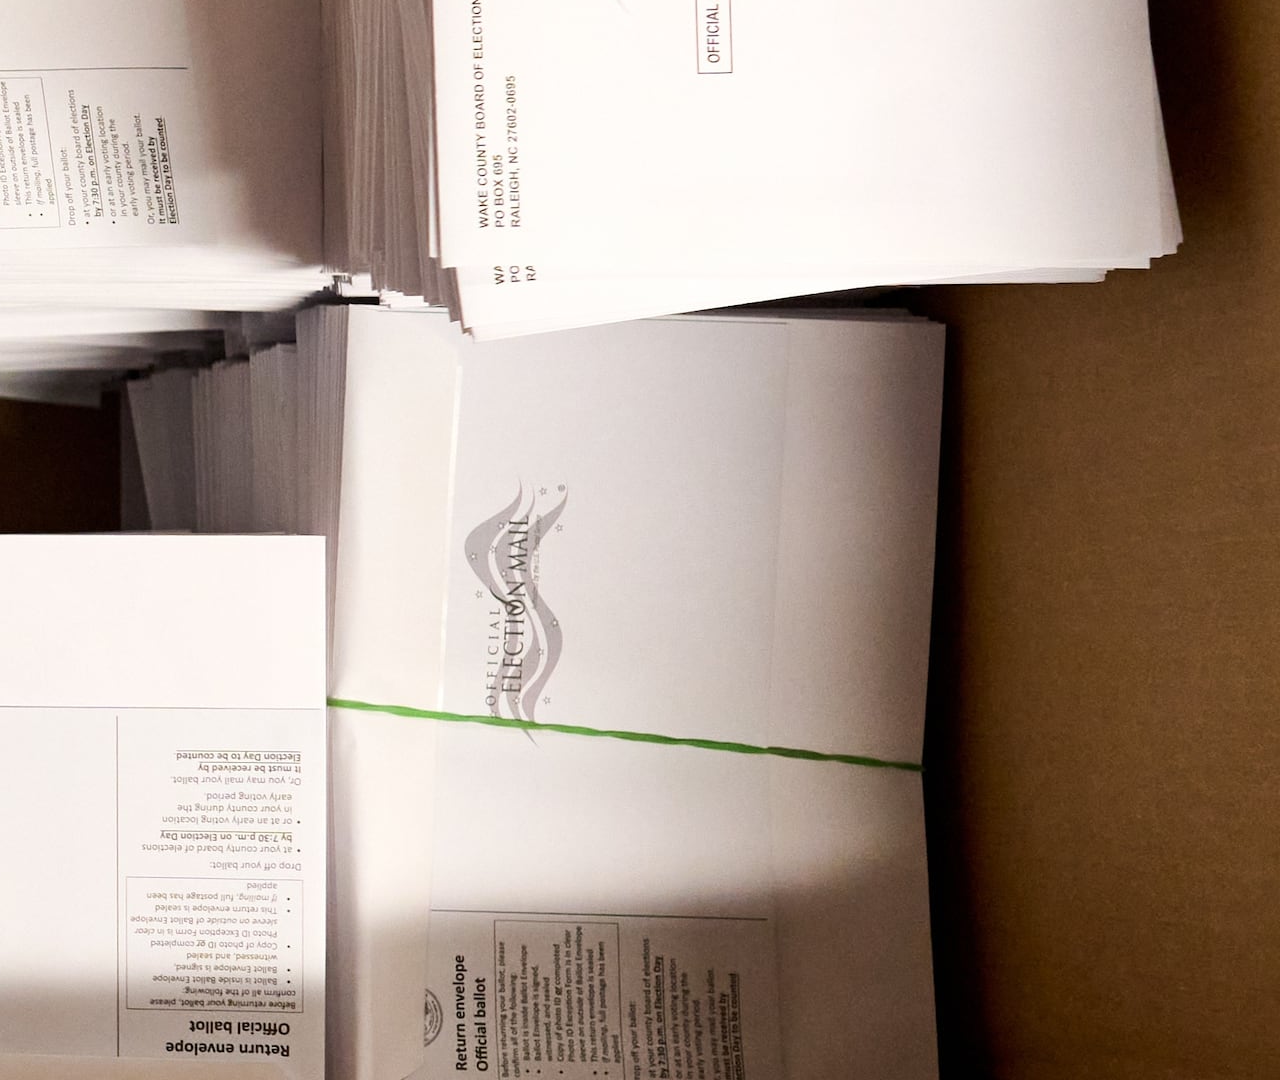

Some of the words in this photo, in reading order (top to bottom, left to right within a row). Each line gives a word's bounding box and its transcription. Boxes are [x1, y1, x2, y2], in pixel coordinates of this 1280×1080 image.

[705, 4, 720, 63] OFFICIAL
[473, 63, 484, 80] OF
[473, 83, 485, 129] BOARD
[505, 75, 517, 142] 27602-0695
[475, 133, 487, 186] COUNTY
[492, 154, 503, 175] 695
[507, 146, 518, 164] NC
[477, 191, 489, 228] WAKE
[493, 179, 504, 206] BOX
[494, 209, 505, 228] PO
[506, 515, 531, 573] MAIL
[484, 607, 501, 708] OFFICIAL
[500, 581, 527, 693] ELECTION
[451, 954, 468, 1019] envelope
[472, 977, 486, 1018] ballot
[165, 1039, 234, 1056] envelope
[188, 1019, 232, 1035] ballot
[237, 1021, 290, 1036] Official
[455, 1023, 468, 1071] Return
[473, 1021, 489, 1072] Official
[238, 1043, 290, 1057] Return
